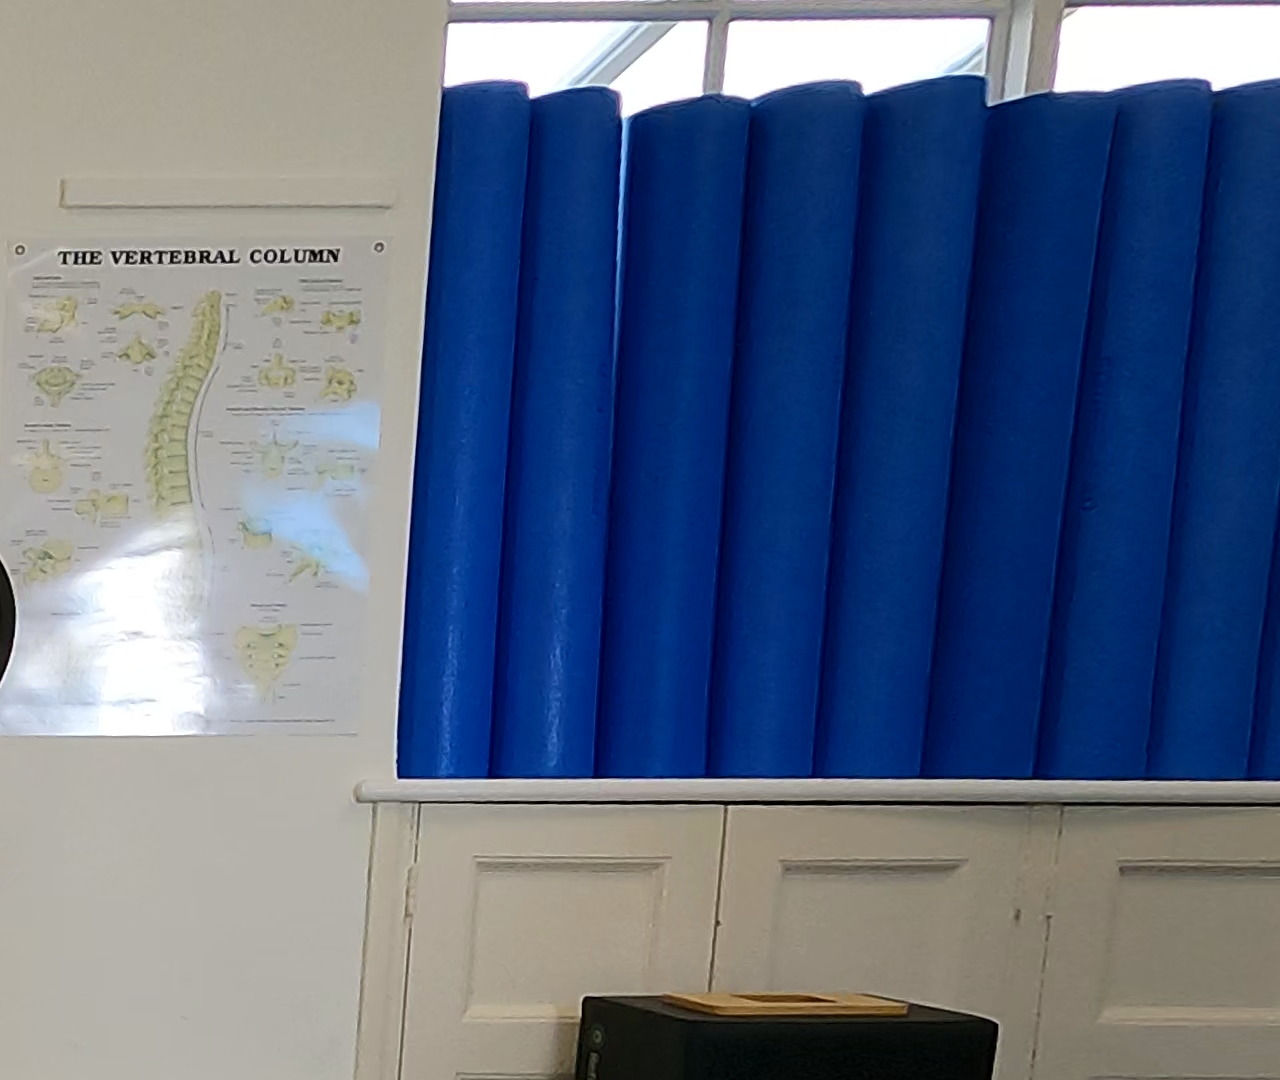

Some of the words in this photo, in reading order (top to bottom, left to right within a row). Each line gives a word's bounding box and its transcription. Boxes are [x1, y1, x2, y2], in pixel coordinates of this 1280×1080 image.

[57, 250, 103, 265] THE
[111, 249, 241, 265] VERTEBRAL
[249, 248, 341, 264] COLUMN
